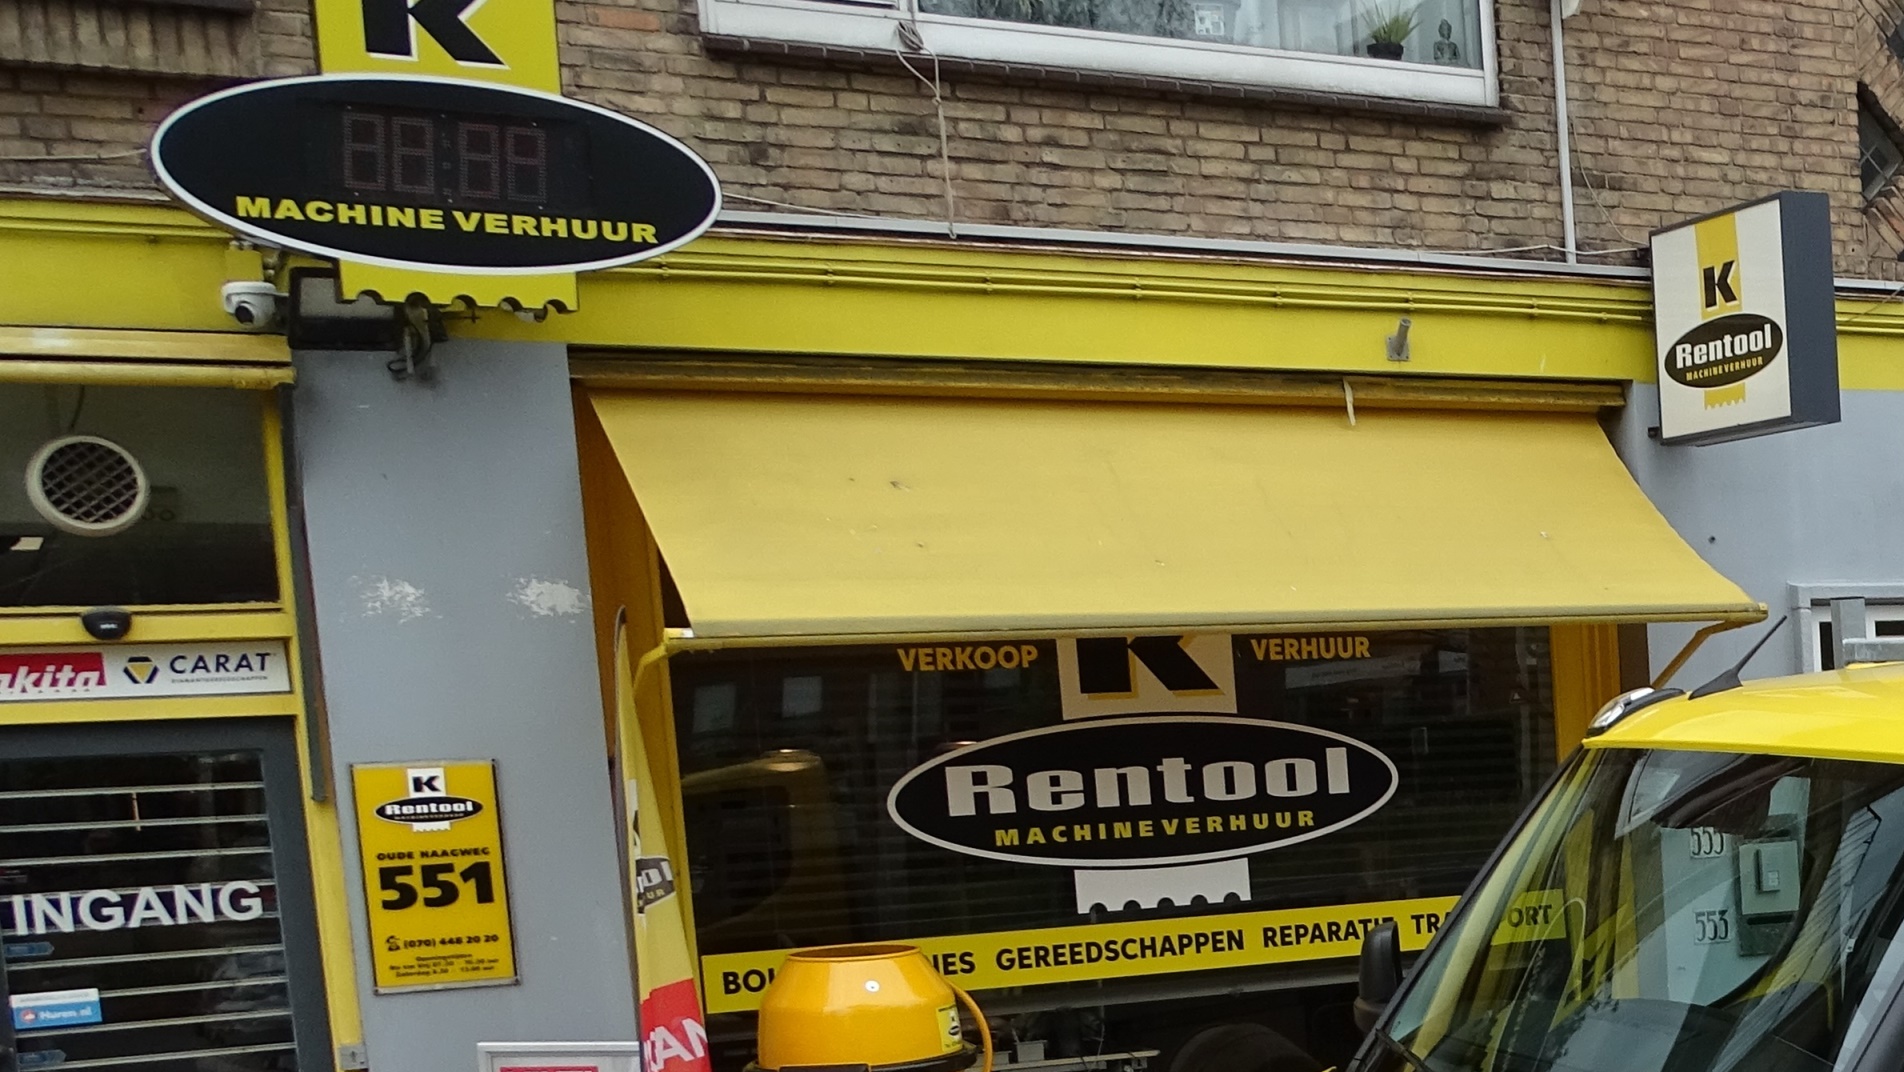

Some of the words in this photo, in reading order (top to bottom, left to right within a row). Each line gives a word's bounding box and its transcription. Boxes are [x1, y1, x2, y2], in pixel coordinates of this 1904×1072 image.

[236, 196, 445, 231] MACHINE
[450, 210, 659, 244] VERHUUR
[1702, 259, 1740, 311] K
[1676, 324, 1772, 369] Rentool
[1686, 356, 1763, 381] MACHINEVERHUUR
[169, 652, 271, 674] CARAT
[899, 645, 1039, 672] VERKOOP
[1250, 636, 1372, 661] VERHUUR
[413, 775, 441, 793] K
[944, 747, 1351, 818] Rentool
[385, 801, 474, 815] Rentool
[995, 809, 1316, 848] MACHINEVERHUUR
[378, 861, 495, 911] 551
[12, 880, 263, 936] INGANG
[1695, 909, 1728, 942] 553
[466, 935, 481, 944] 20
[483, 934, 499, 942] 20
[996, 928, 1244, 973] GEREEDSCHAPPEN
[1263, 916, 1394, 950] REPARAT
